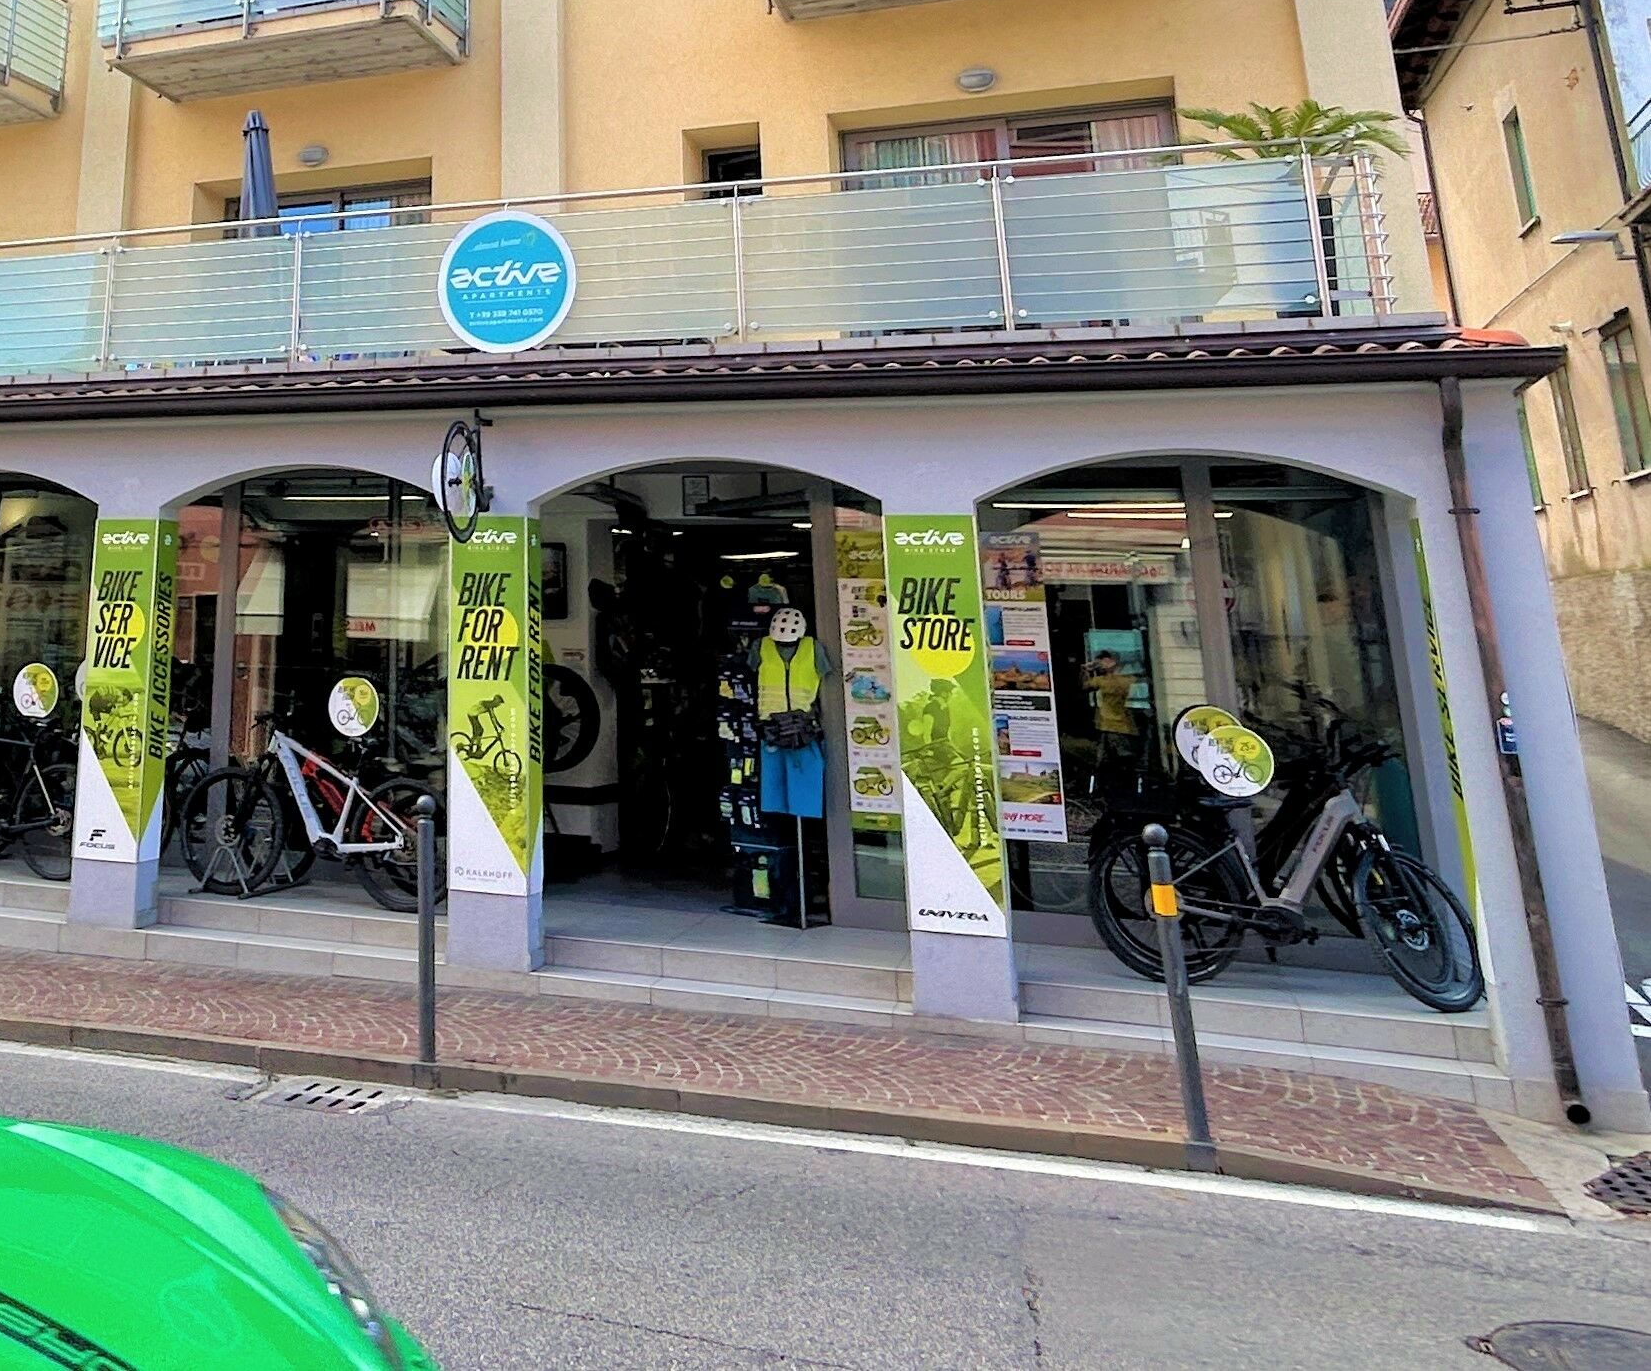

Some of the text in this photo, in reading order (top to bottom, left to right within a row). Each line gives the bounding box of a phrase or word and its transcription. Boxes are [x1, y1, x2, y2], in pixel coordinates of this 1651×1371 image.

[450, 259, 563, 290] active
[462, 288, 552, 301] APARTMENTS
[102, 531, 149, 545] active
[466, 529, 518, 545] ctive
[894, 529, 966, 546] active
[97, 570, 143, 602] BIKE
[457, 572, 512, 608] BIKE
[898, 577, 962, 616] BIKE
[984, 588, 1027, 601] TOURS
[95, 603, 134, 635] SER
[457, 608, 505, 644] FOR
[900, 617, 976, 651] STORE
[93, 636, 137, 669] VICE
[148, 572, 174, 761] BIKE ACCESSORIES
[457, 645, 520, 681] RENT
[528, 577, 542, 765] BIKE FOR RENT
[79, 840, 116, 851] FOCUS
